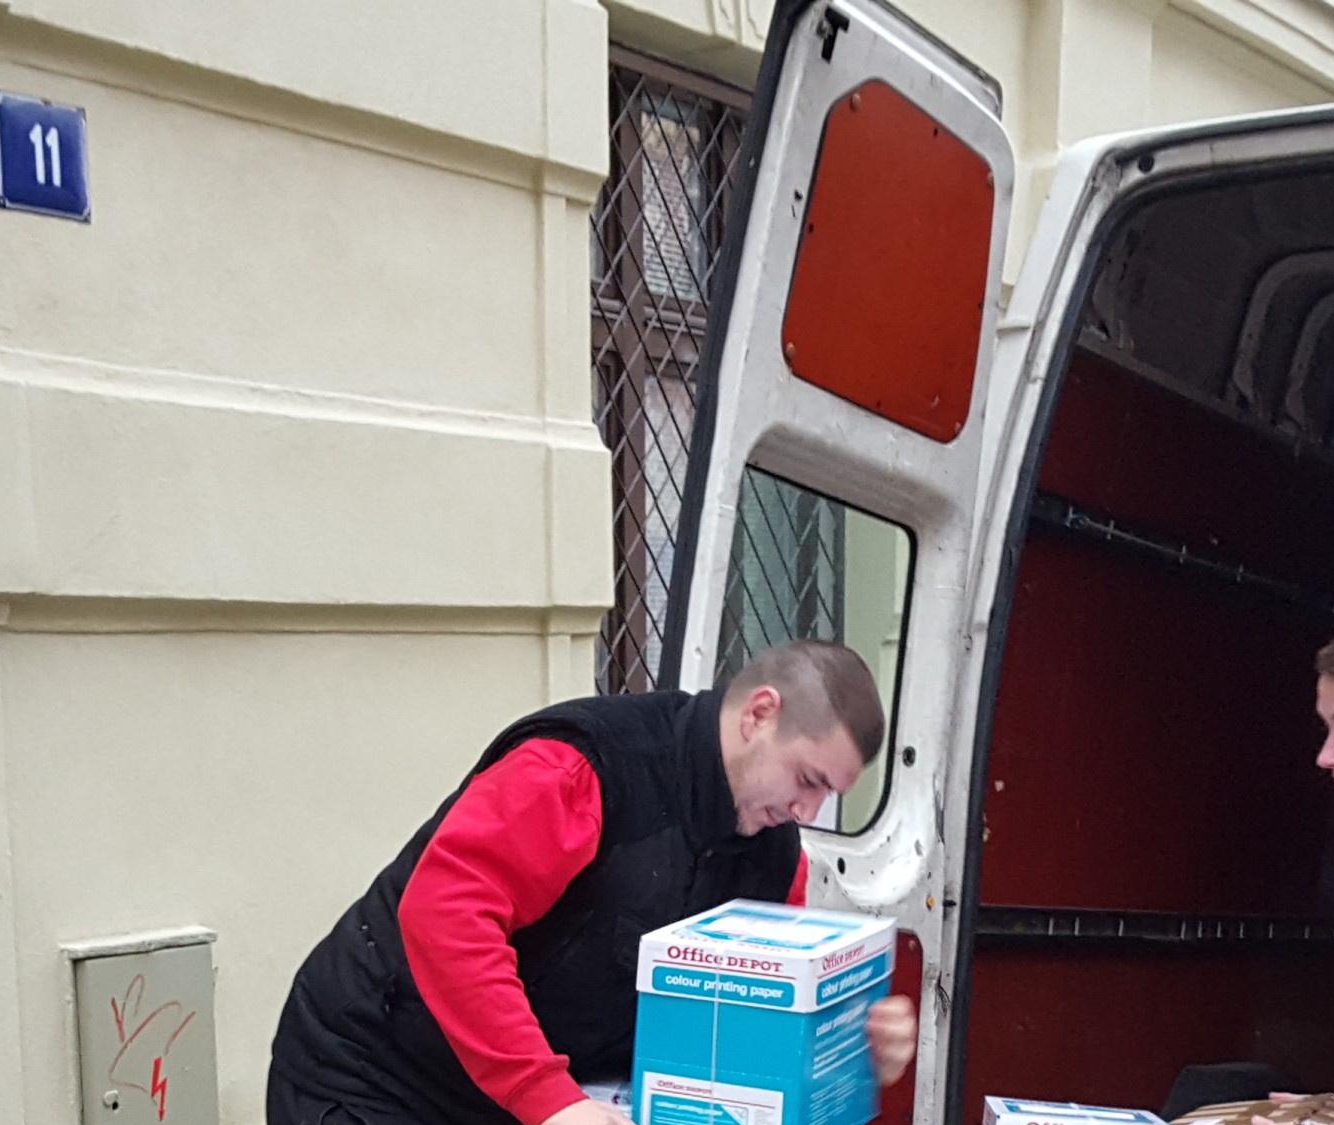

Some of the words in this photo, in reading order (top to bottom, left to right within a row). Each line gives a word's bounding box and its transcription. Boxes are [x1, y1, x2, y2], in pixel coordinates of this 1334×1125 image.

[29, 122, 62, 188] 11
[667, 945, 723, 965] Office
[727, 956, 784, 973] DEPOT
[665, 974, 702, 987] colour
[750, 985, 784, 999] paper
